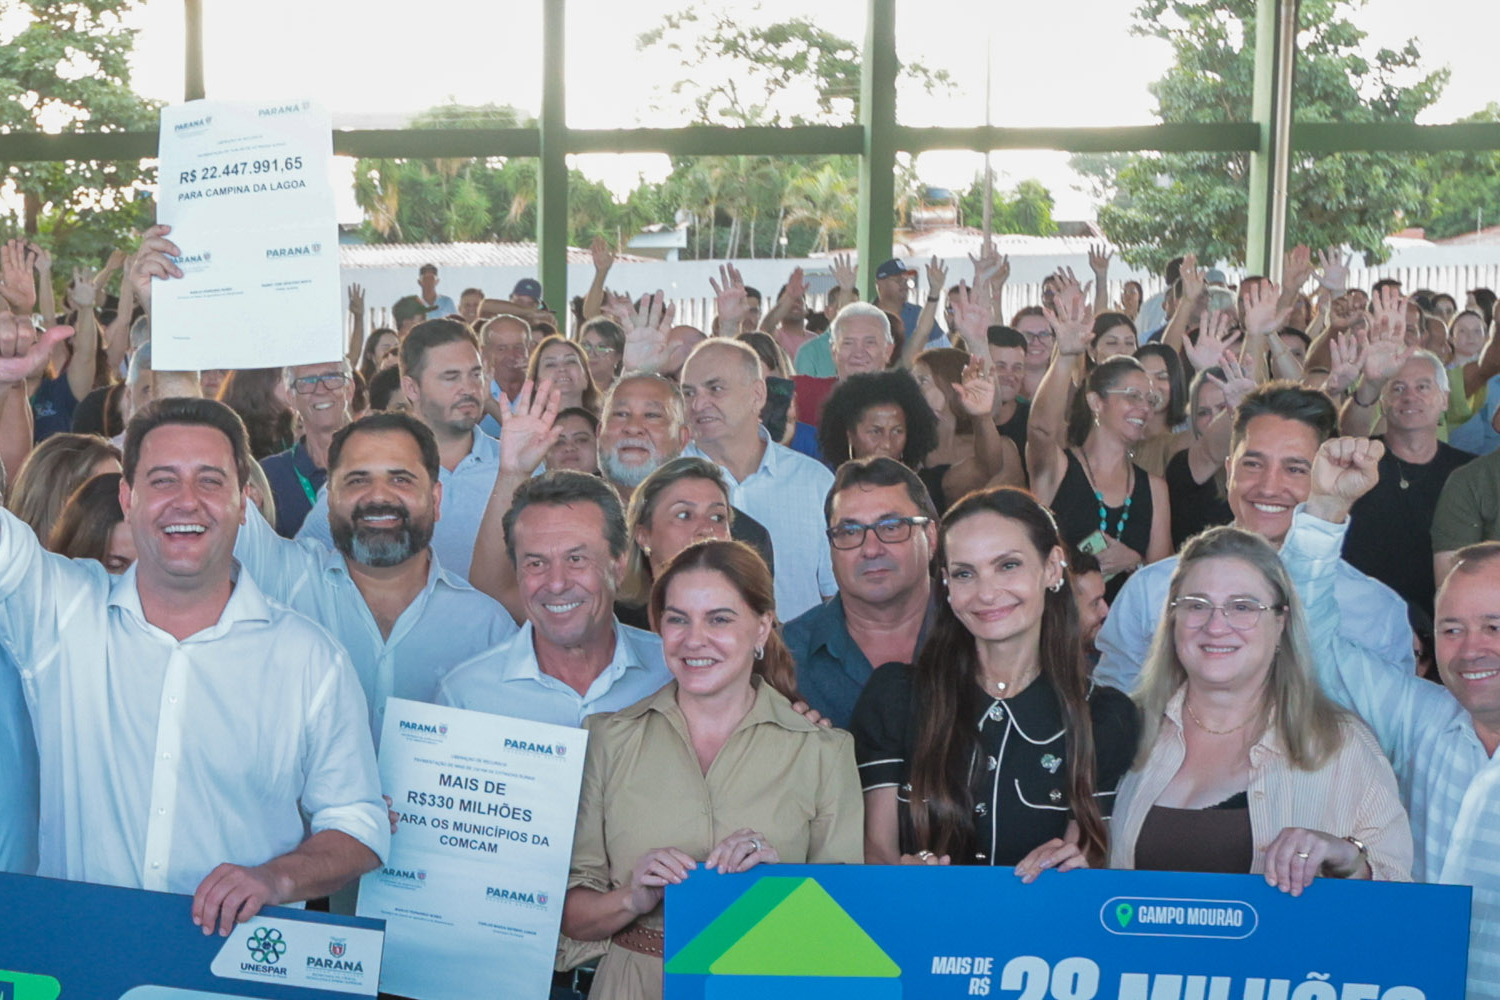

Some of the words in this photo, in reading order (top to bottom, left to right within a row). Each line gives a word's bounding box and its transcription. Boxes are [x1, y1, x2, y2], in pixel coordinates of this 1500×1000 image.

[180, 169, 197, 184] R$
[202, 156, 303, 181] 22.447.991,65
[178, 190, 202, 202] PARA
[206, 184, 250, 198] CAMPINA
[253, 183, 267, 193] DA
[270, 180, 306, 191] LAGOA
[399, 720, 437, 734] PARANÁ
[504, 738, 553, 755] PARANÁ
[439, 773, 479, 792] MAIS
[484, 781, 507, 796] DE
[407, 790, 454, 810] R$330
[459, 798, 533, 823] MILHÕES
[431, 817, 449, 830] OS
[452, 820, 528, 843] MUNICÍPIOS
[531, 834, 550, 847] DA
[440, 834, 498, 853] COMCAM
[382, 867, 416, 880] ARANÁ
[486, 886, 534, 904] PARANÁ
[1137, 905, 1184, 925] CAMPO
[1187, 905, 1243, 927] MOURÃO
[240, 962, 287, 975] UNESPAR
[307, 956, 363, 972] PARANÁ
[932, 956, 971, 975] MAIS
[973, 957, 993, 976] DE
[968, 977, 990, 996] R$
